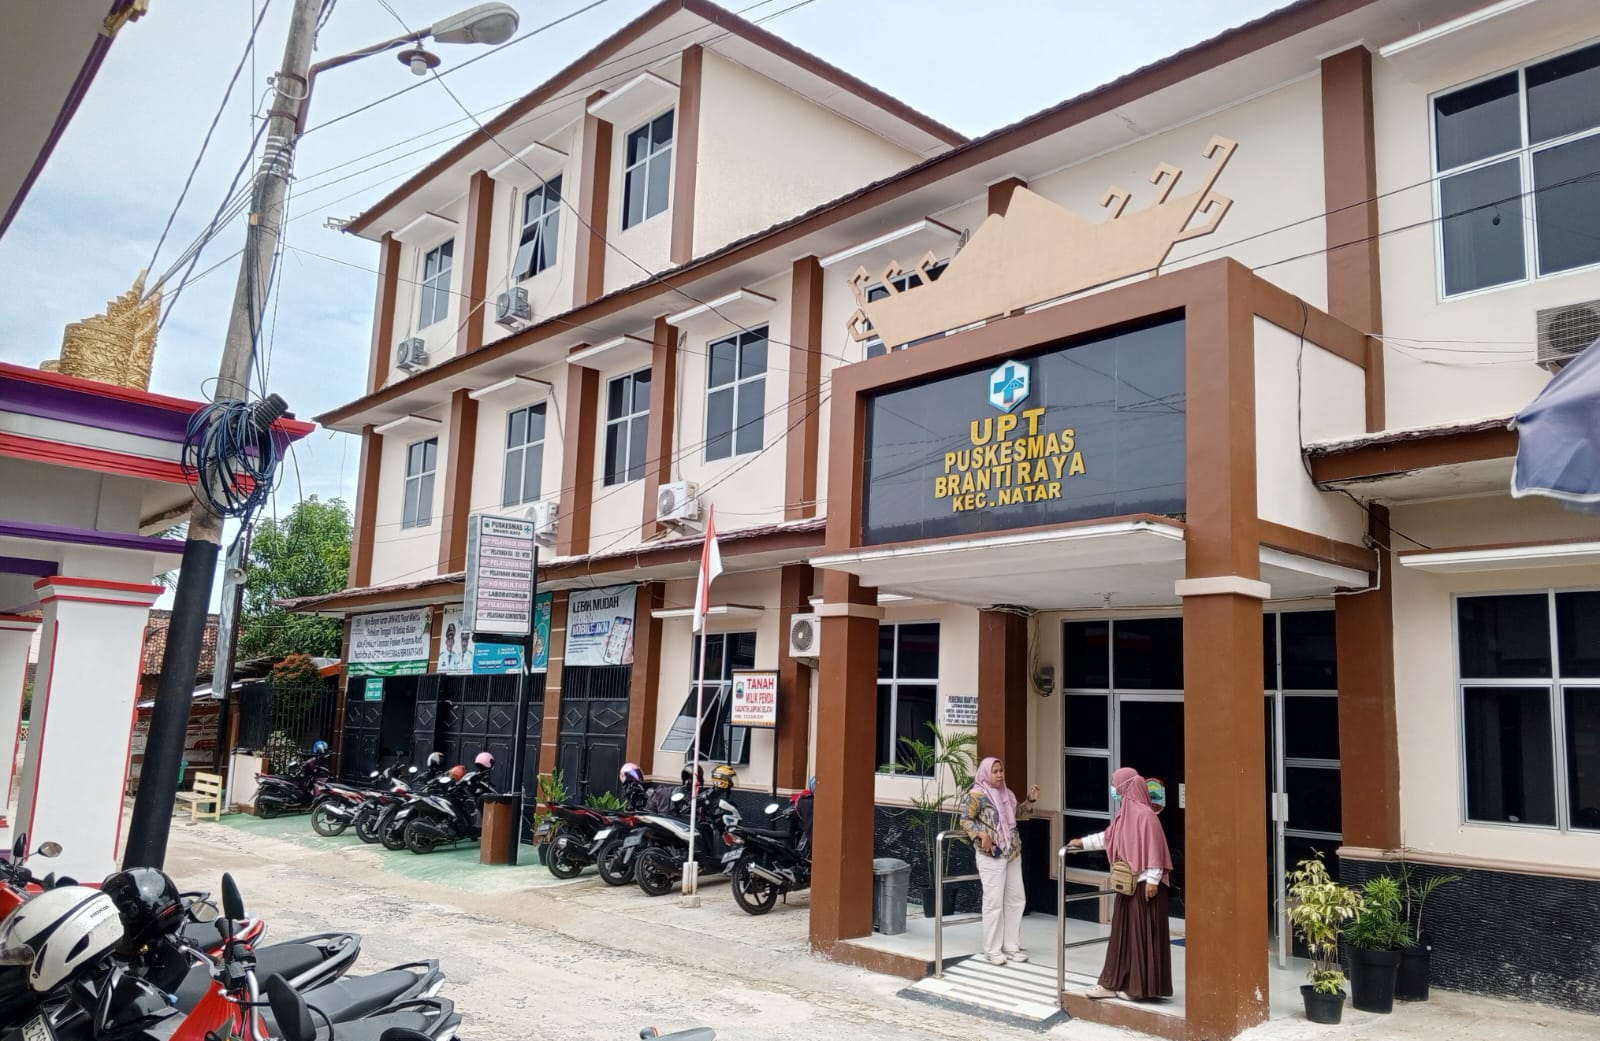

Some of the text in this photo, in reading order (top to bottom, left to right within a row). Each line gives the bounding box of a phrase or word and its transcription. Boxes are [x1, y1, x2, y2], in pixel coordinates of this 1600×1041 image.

[970, 407, 1046, 446] UPT
[944, 428, 1076, 474] PUSKESMAS
[935, 451, 1087, 499] BRANTI RAYA
[491, 521, 523, 531] PUSKESMAS
[488, 591, 528, 599] LABORATORIUM
[573, 596, 619, 612] LEBIH MUDAH
[746, 678, 774, 690] TANAH
[746, 692, 774, 704] MILIK PEMDA
